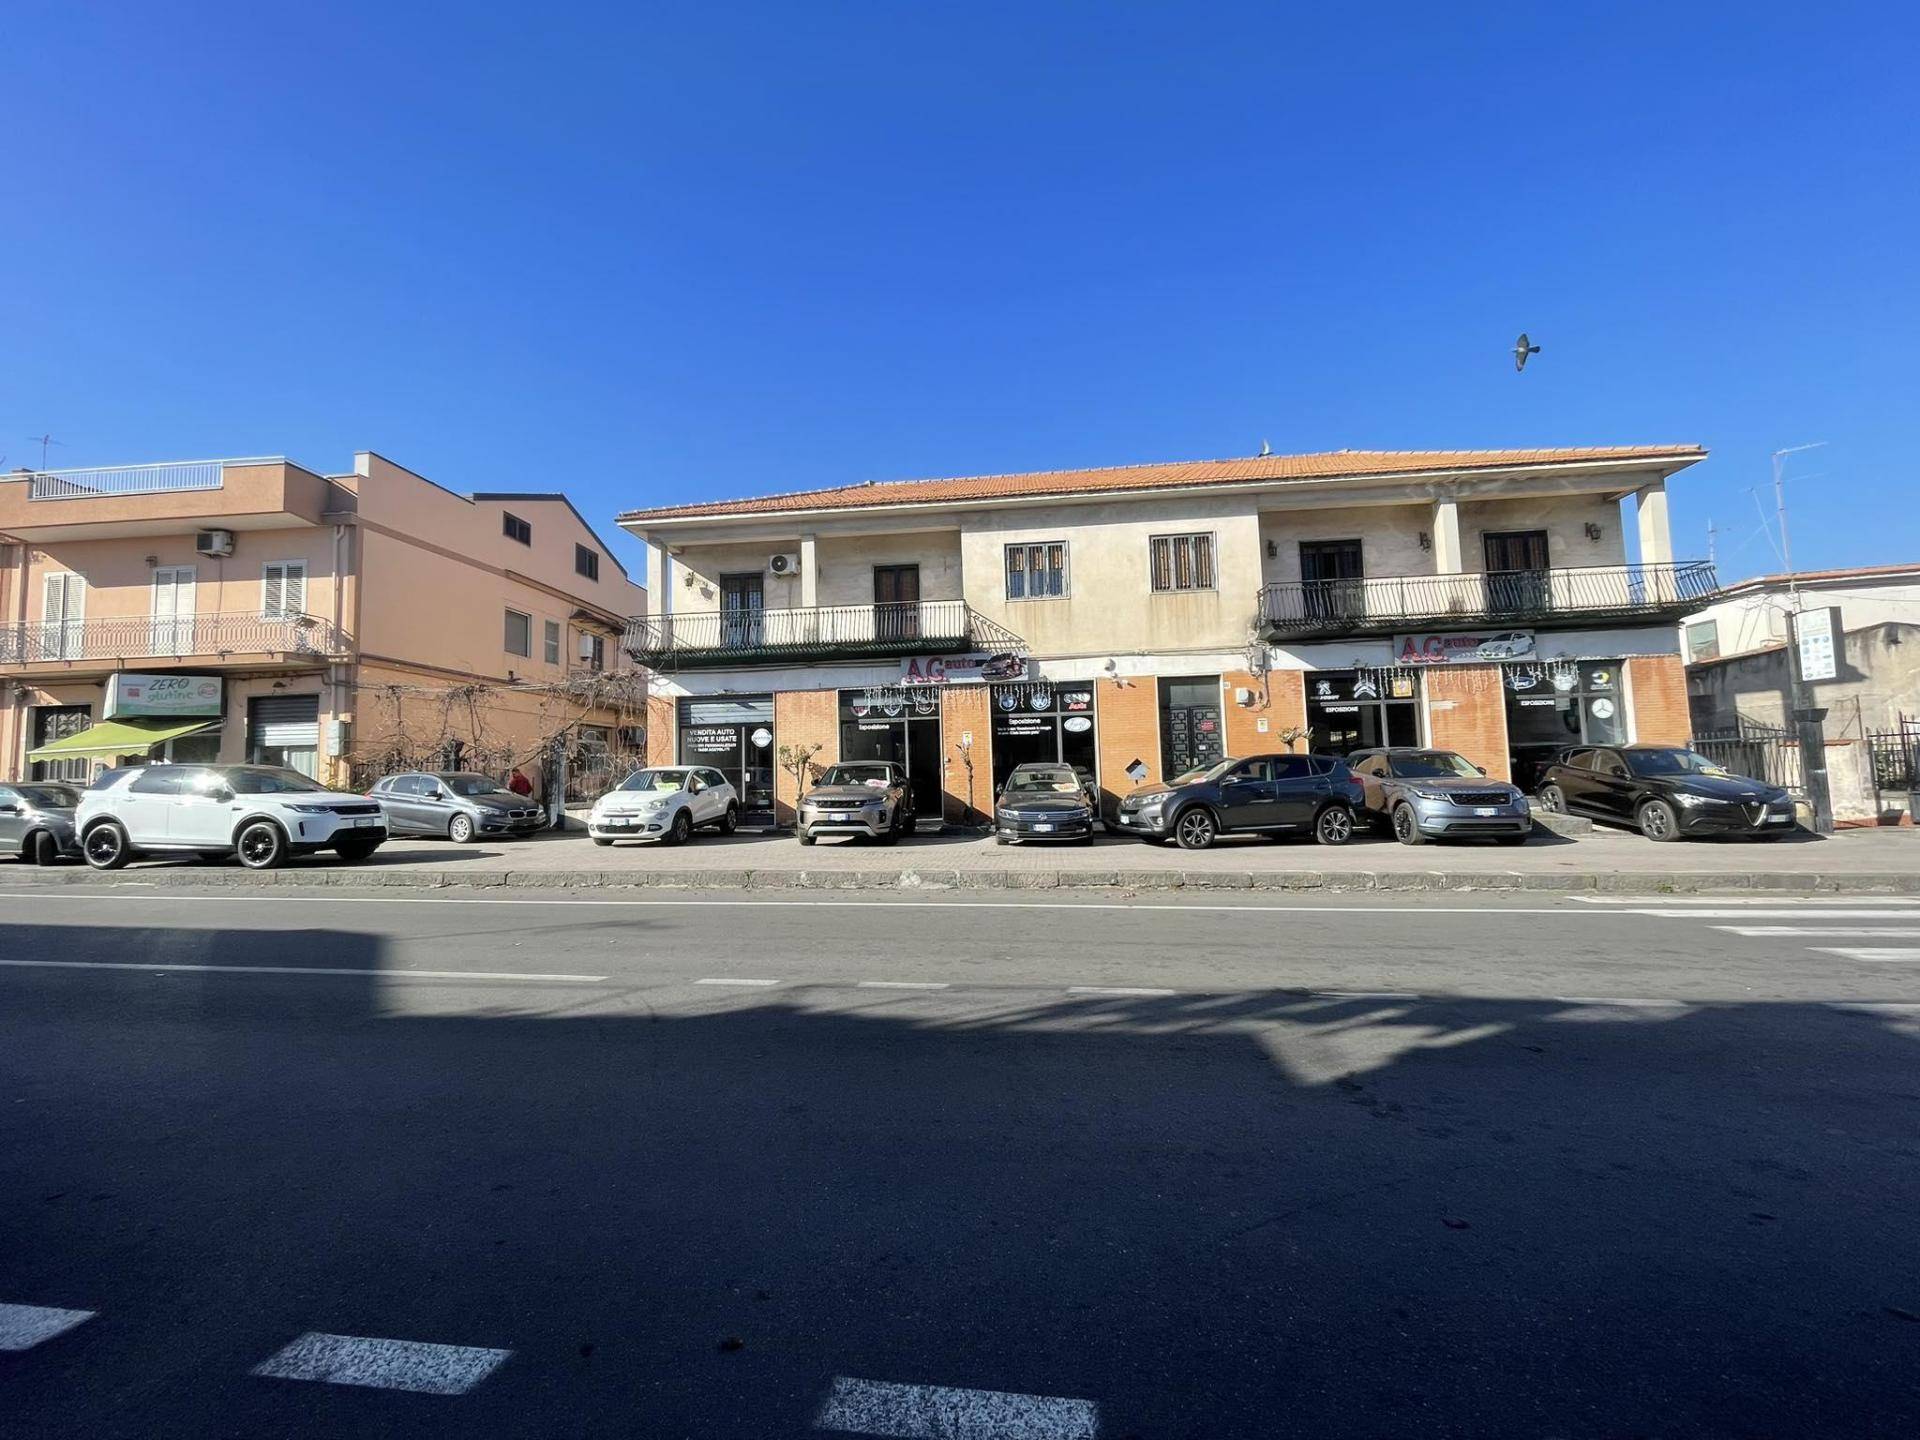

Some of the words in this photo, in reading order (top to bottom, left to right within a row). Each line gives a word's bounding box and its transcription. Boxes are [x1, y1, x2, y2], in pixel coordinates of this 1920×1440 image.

[149, 678, 190, 690] ZERO
[147, 690, 194, 703] glutine
[690, 728, 716, 736] VENDITA
